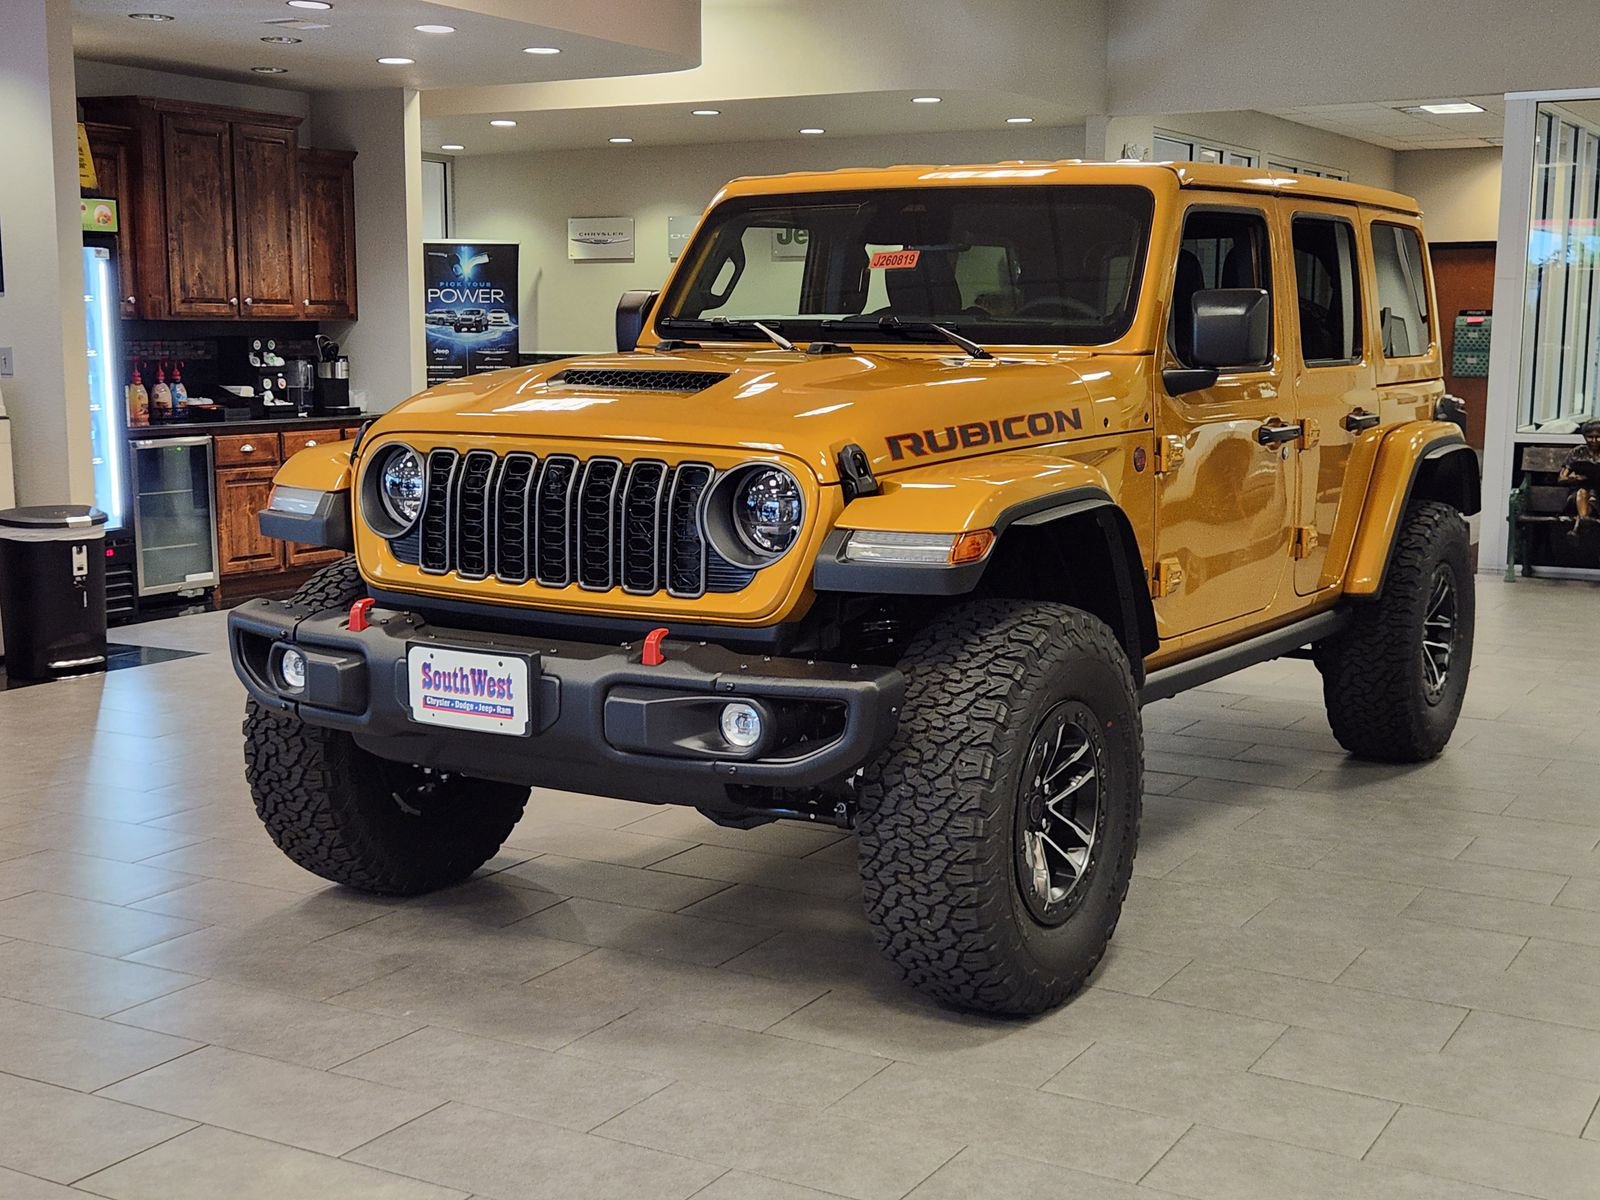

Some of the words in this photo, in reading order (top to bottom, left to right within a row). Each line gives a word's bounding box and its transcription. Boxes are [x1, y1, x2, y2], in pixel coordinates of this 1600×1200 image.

[873, 254, 916, 268] J260819
[427, 288, 505, 304] POWER
[433, 348, 450, 356] Jeep
[885, 407, 1083, 461] RUBICON
[421, 661, 514, 701] SouthWest
[426, 696, 450, 708] Chrysler
[455, 700, 474, 711] Dodge
[478, 703, 494, 714] Jeep
[496, 705, 512, 715] Ram
